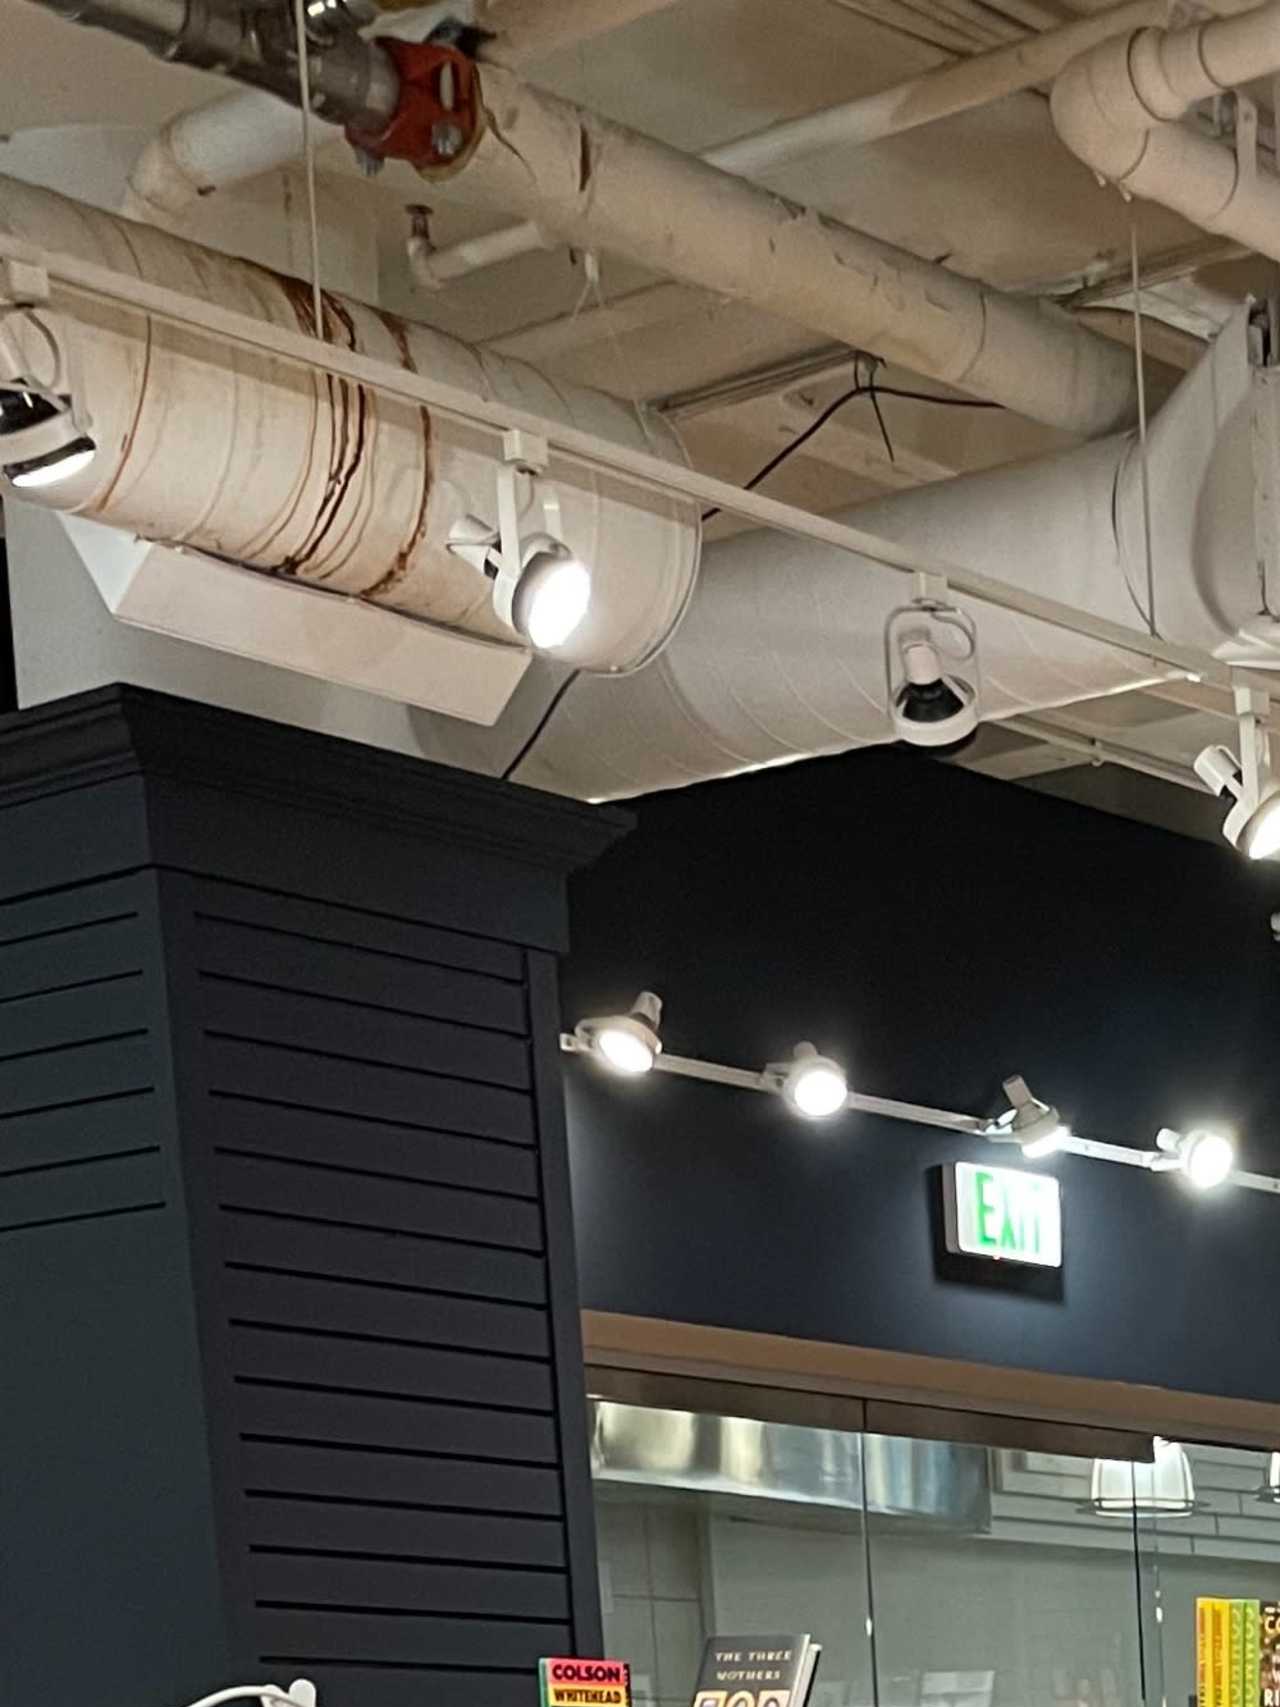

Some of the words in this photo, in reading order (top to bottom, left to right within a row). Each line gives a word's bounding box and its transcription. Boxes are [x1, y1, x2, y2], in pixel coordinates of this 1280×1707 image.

[976, 1171, 1043, 1256] EXIT
[716, 1652, 741, 1662] THE
[749, 1650, 792, 1662] THREE
[552, 1664, 621, 1684] COLSON
[716, 1670, 781, 1682] MOTHERS
[554, 1688, 622, 1704] WHITEHEAD
